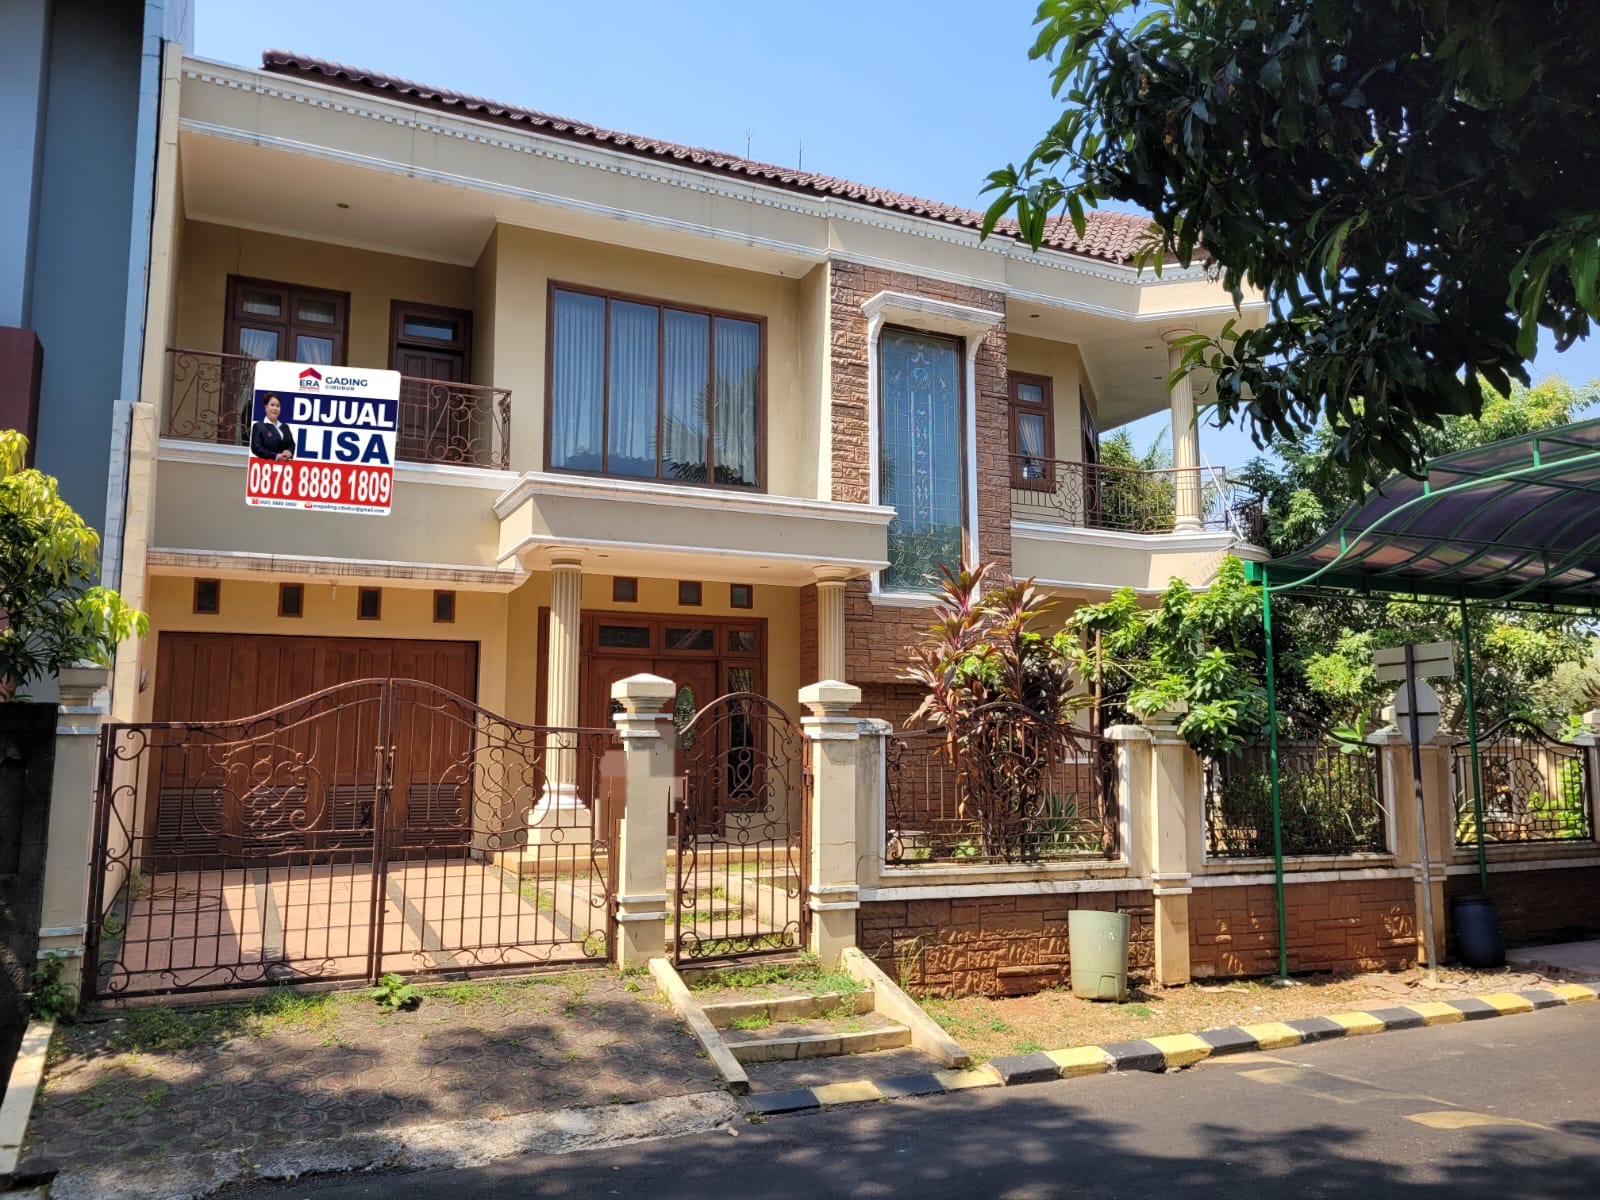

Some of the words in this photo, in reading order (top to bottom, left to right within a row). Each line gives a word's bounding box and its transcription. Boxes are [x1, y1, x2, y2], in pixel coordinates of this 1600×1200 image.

[299, 379, 320, 387] ERA
[325, 376, 368, 387] GADING
[292, 397, 394, 428] DIJUAL
[296, 428, 390, 465] LISA
[249, 462, 294, 497] 0878
[298, 466, 342, 500] 8888
[348, 469, 391, 503] 1809
